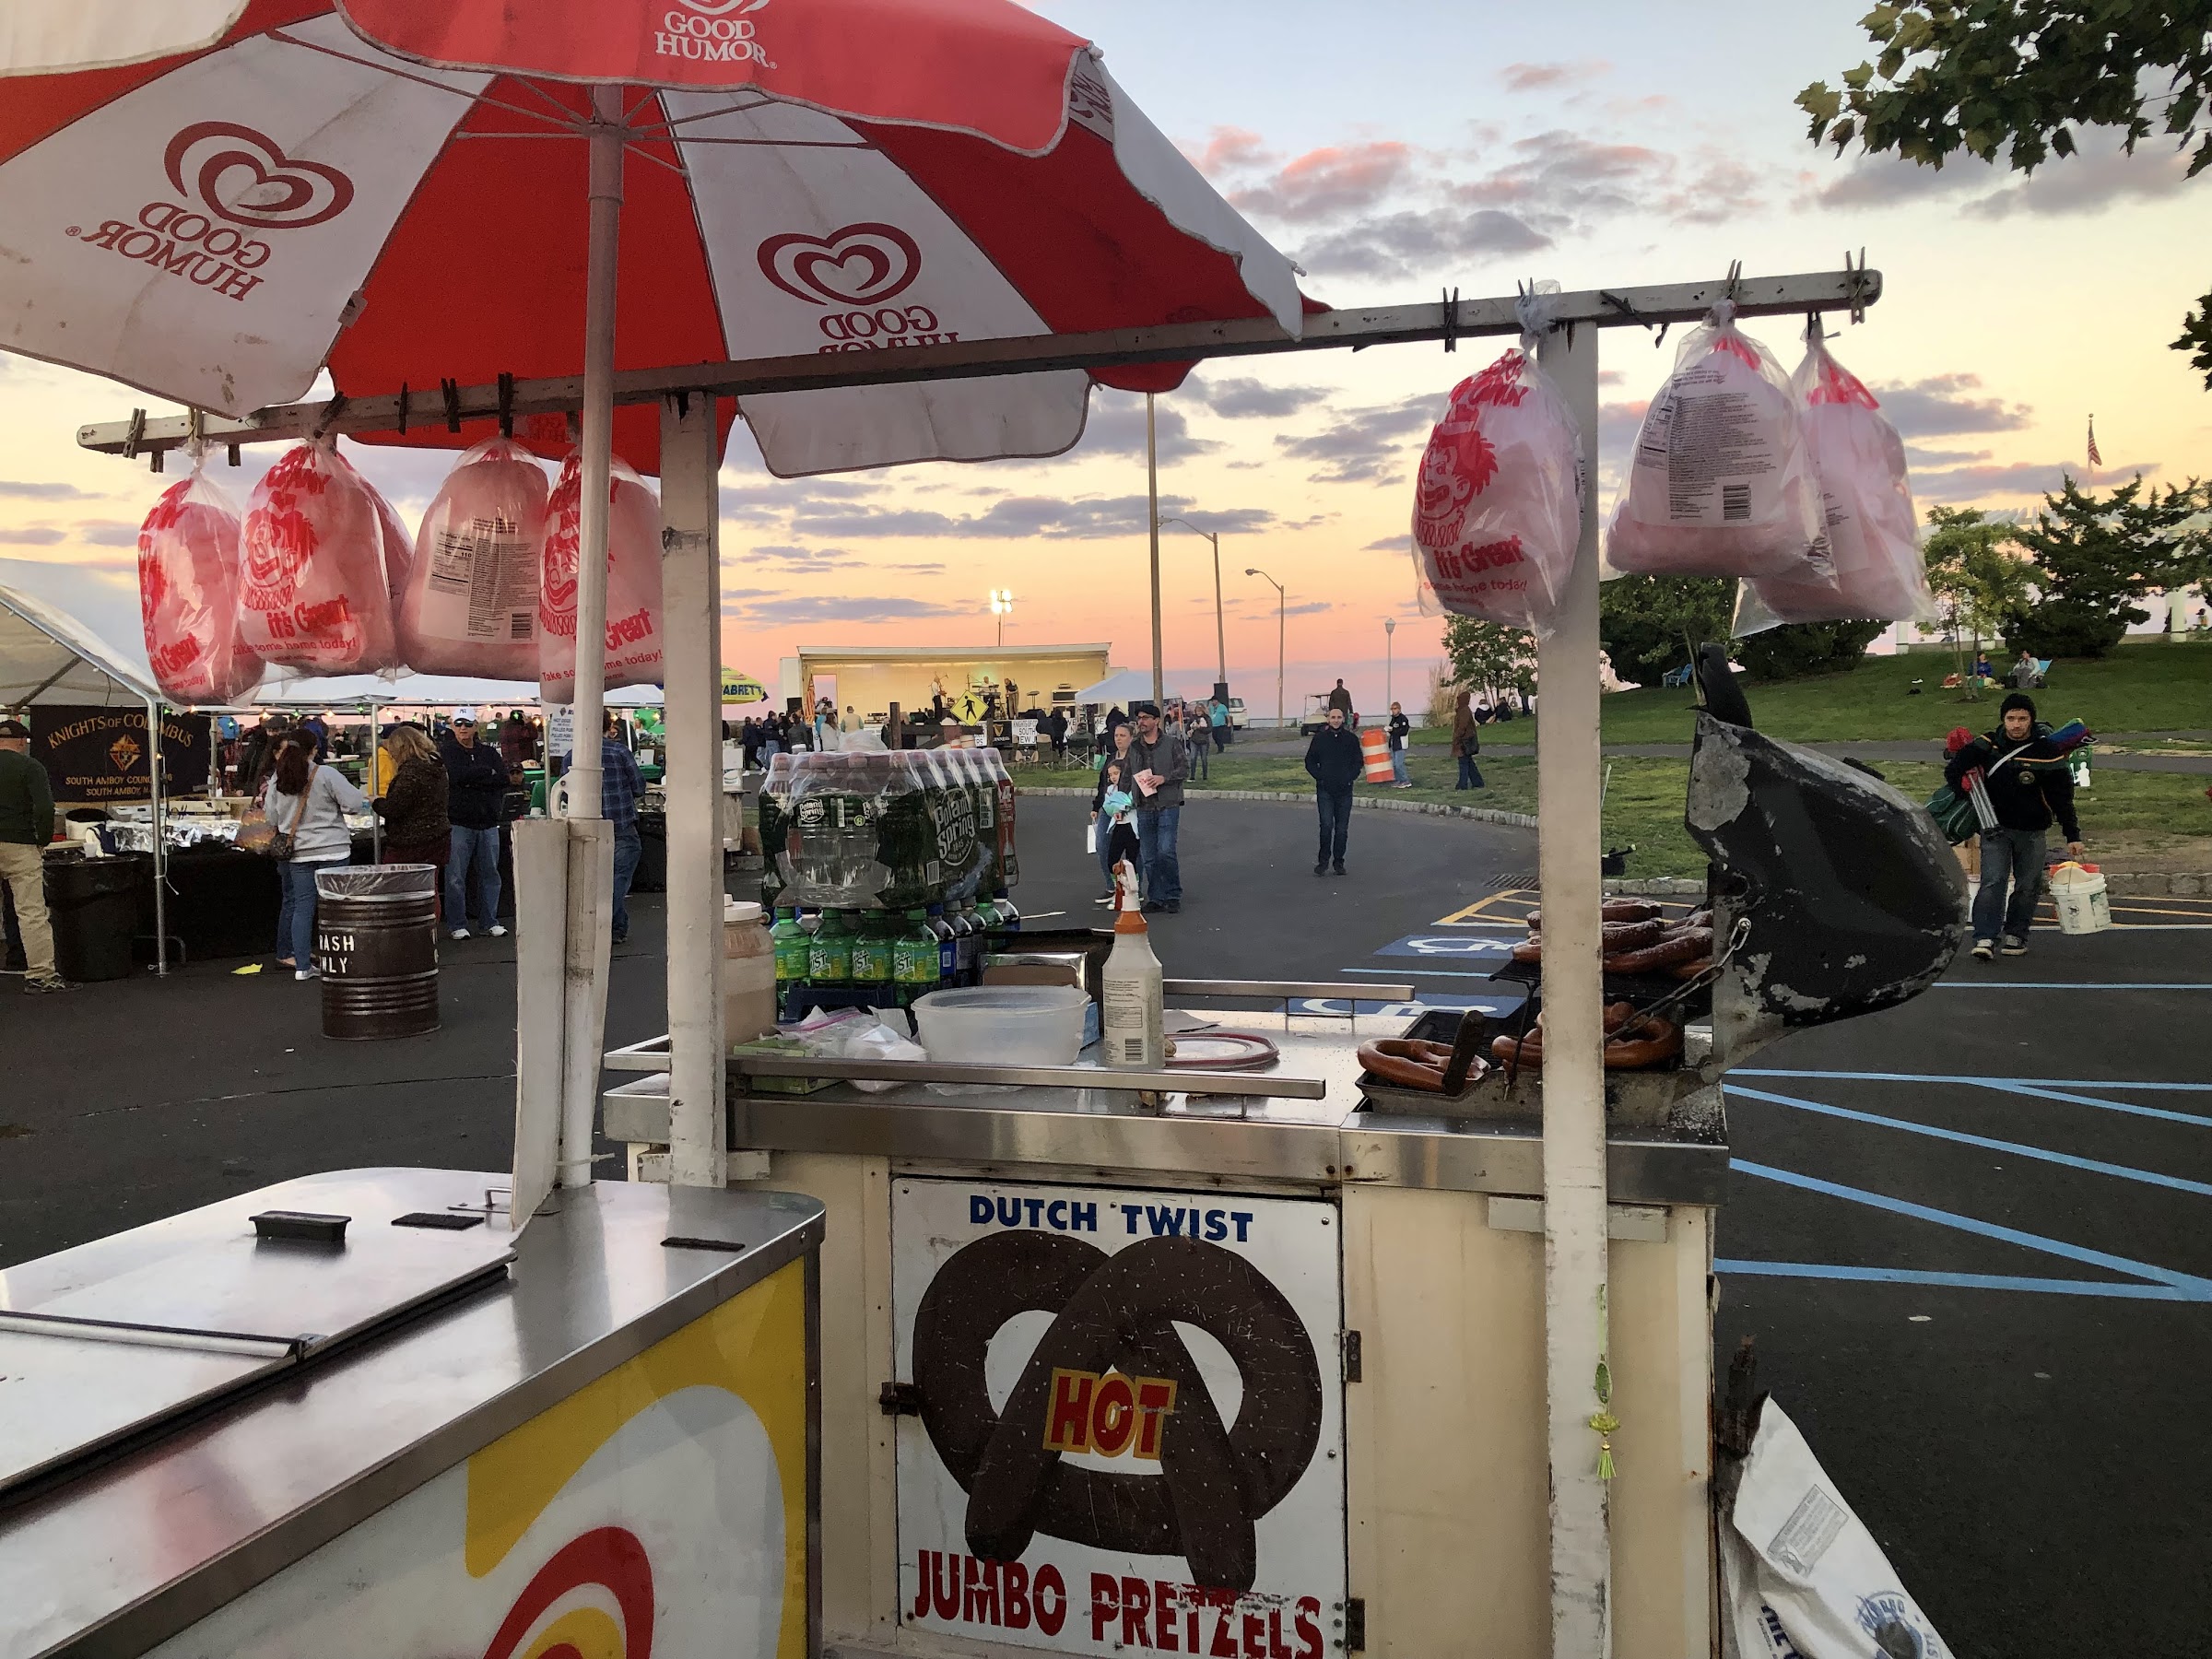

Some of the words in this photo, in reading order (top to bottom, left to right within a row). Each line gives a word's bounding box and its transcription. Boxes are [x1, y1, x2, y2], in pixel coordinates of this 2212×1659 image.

[665, 11, 756, 41] GOOD
[653, 31, 770, 68] HUMOR
[1461, 535, 1524, 573] Great
[542, 671, 563, 683] Take
[563, 669, 576, 680] so
[625, 649, 664, 665] today!
[722, 684, 762, 696] ABRETT
[48, 715, 107, 749] KNIGHTS
[107, 717, 123, 728] OF
[123, 713, 194, 747] COLMBUS
[1018, 727, 1036, 735] SOUTH
[1019, 735, 1030, 744] EW
[65, 776, 93, 785] SOUTH
[97, 776, 124, 785] AMBOY
[126, 775, 153, 784] COUNC
[86, 787, 112, 796] SOUTH
[799, 799, 824, 811] Poland
[800, 807, 825, 820] Spring
[934, 797, 972, 836] Poland
[937, 814, 976, 860] Spring
[319, 934, 355, 952] RASH
[320, 956, 348, 974] NLY
[971, 1195, 1097, 1231] DUTCH
[1121, 1204, 1253, 1242] TWIST
[1046, 1371, 1175, 1457] HOT
[915, 1549, 1067, 1636] JUMBO
[1090, 1571, 1324, 1659] PRETZELS
